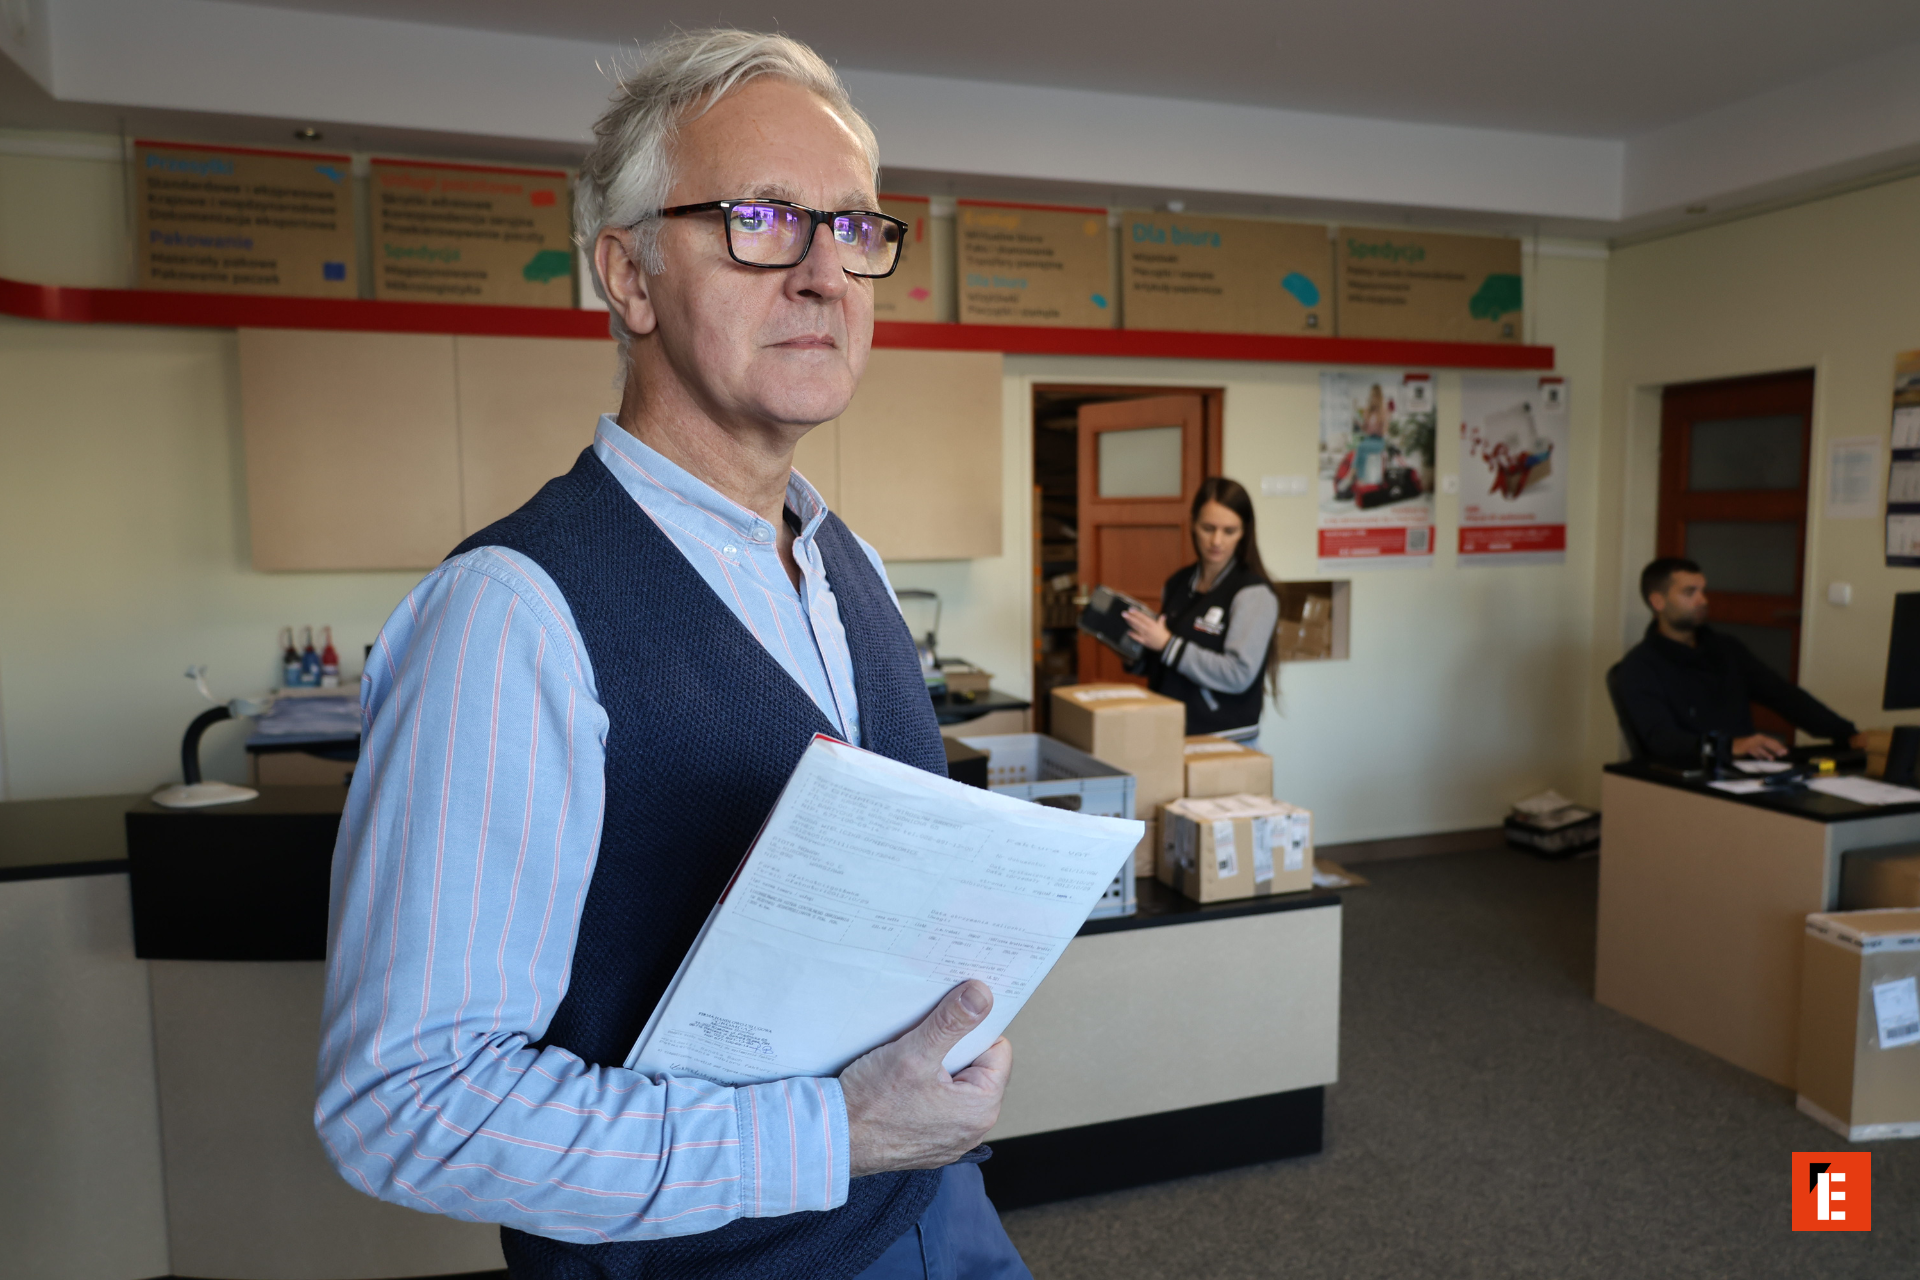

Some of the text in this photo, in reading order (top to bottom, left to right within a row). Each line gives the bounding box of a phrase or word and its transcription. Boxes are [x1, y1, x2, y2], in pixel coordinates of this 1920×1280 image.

[1132, 223, 1222, 248] Dla biura
[1346, 238, 1427, 265] Spedycja
